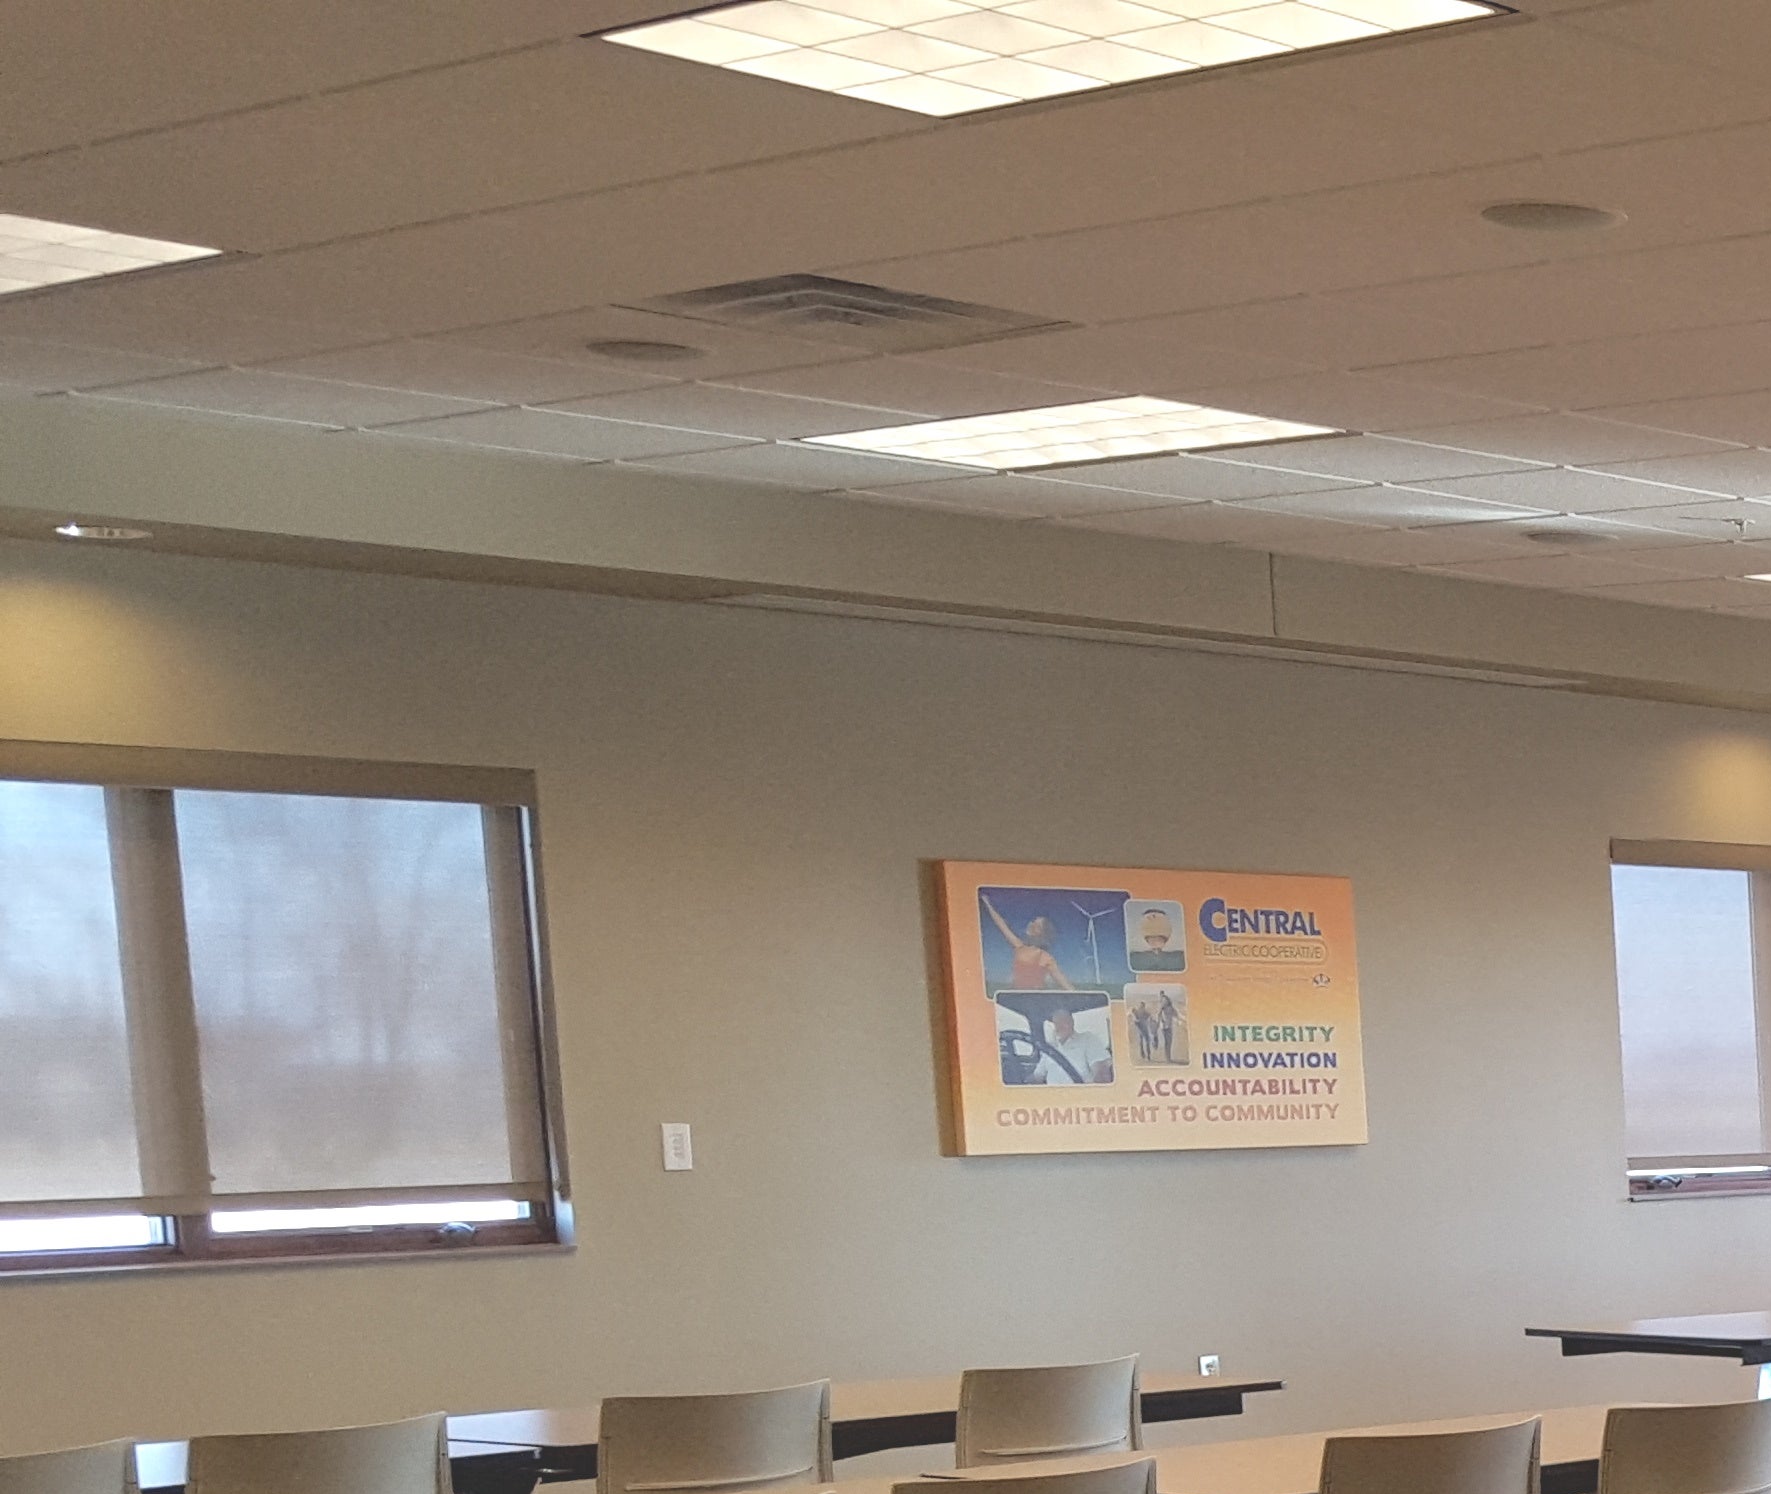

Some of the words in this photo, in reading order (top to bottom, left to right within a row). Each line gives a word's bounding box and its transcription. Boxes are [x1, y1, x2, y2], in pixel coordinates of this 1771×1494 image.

[1199, 897, 1321, 942] CENTRAL
[1203, 943, 1249, 957] ELECTRIC
[1251, 944, 1321, 959] COOPERATIVE
[1213, 1025, 1335, 1042] INTEGRITY
[1202, 1052, 1337, 1068] INNOVATION
[1137, 1078, 1338, 1097] ACCOUNTABILITY
[996, 1105, 1159, 1127] COMMITMENT
[1167, 1105, 1197, 1122] TO
[1205, 1103, 1339, 1122] COMMUNITY
